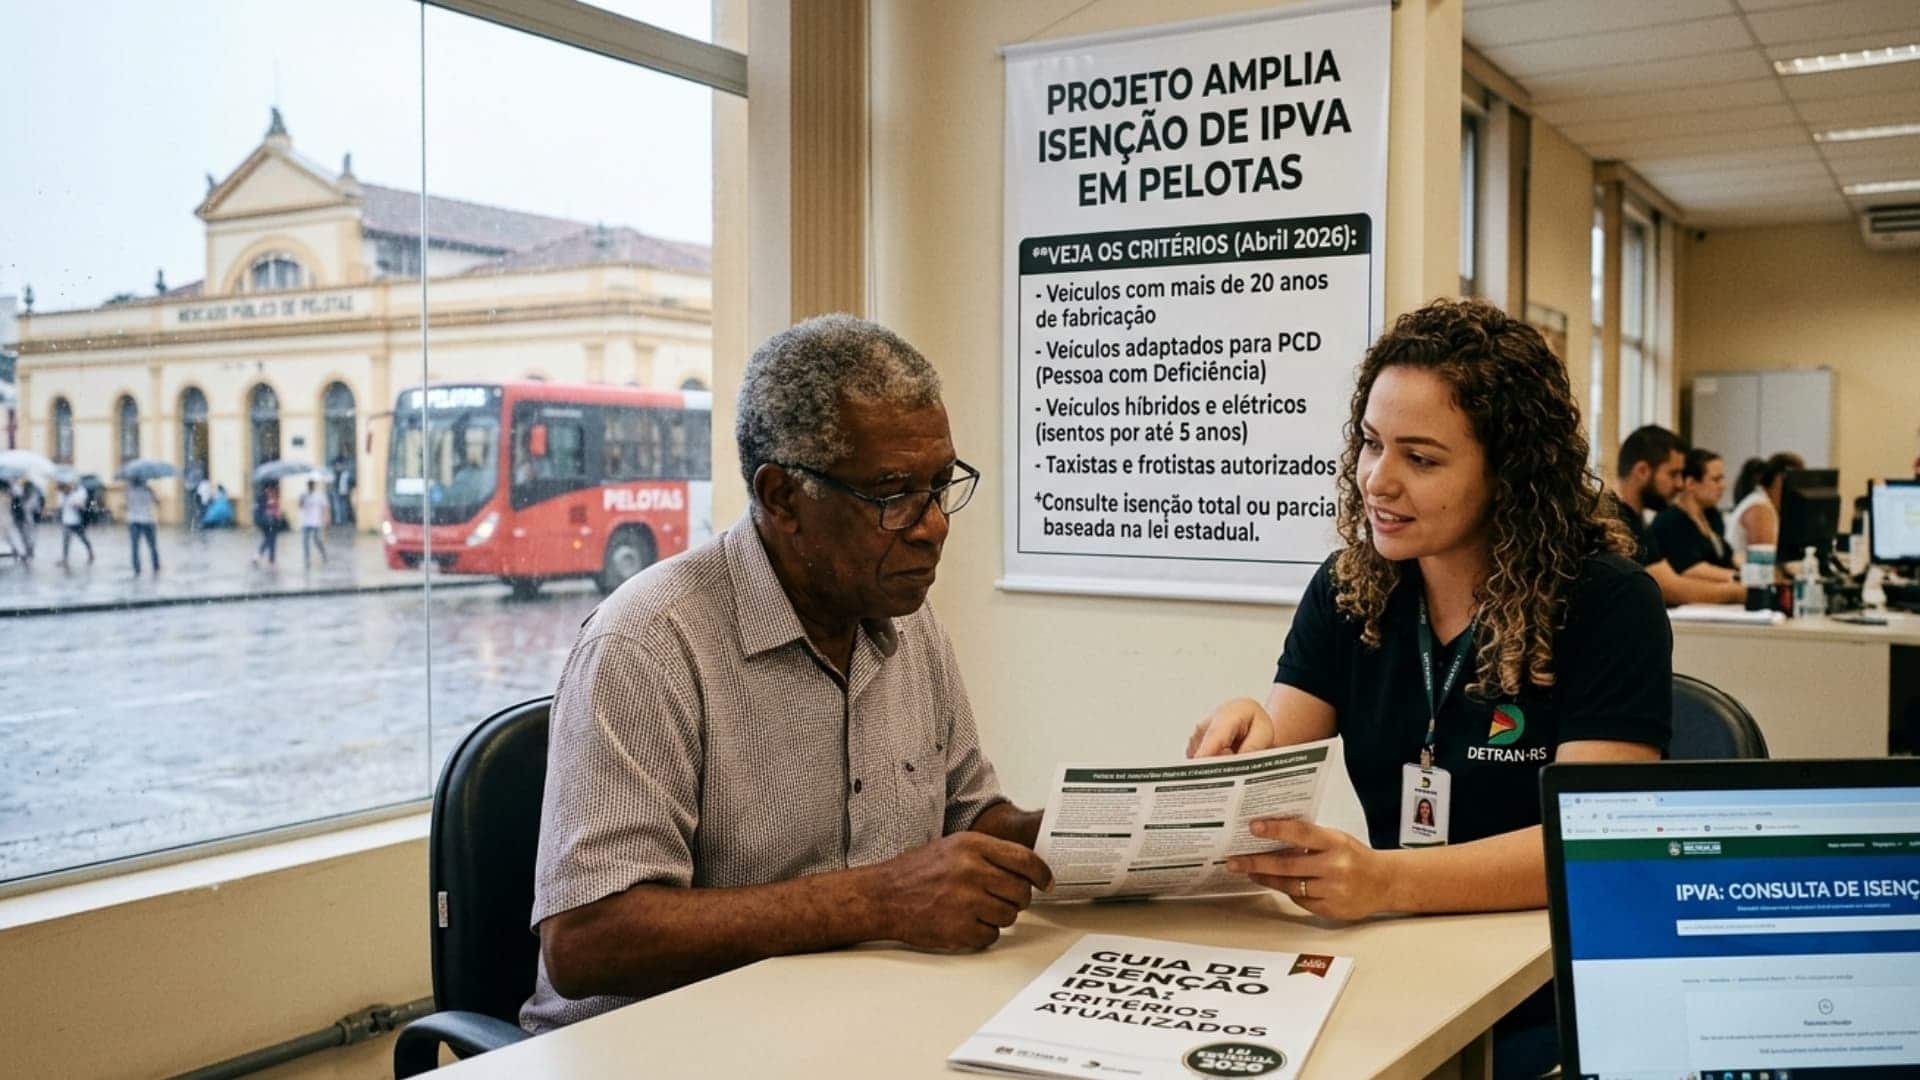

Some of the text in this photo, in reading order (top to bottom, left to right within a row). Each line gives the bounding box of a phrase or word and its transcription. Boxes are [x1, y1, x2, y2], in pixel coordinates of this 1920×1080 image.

[1047, 49, 1341, 115] PROJETO AMPLIA
[1039, 98, 1351, 164] ISENÇÃO DE IPVA
[1079, 154, 1303, 206] EM PELOTAS
[1098, 241, 1123, 261] OS
[1128, 232, 1229, 260] CRITÉRIOS
[1234, 228, 1288, 258] (Abril
[1294, 224, 1357, 251] 2026):
[1126, 282, 1165, 298] com
[1171, 274, 1215, 297] mais
[1221, 274, 1245, 294] de
[1250, 272, 1274, 293] 20
[1280, 272, 1329, 291] anos
[1036, 305, 1156, 330] de fabricação
[1046, 339, 1121, 359] Veículos
[1125, 335, 1224, 360] adaptados
[1230, 336, 1272, 358] para
[1278, 331, 1322, 352] PCD
[1036, 365, 1103, 389] (Pessoa
[1109, 367, 1148, 384] com
[1046, 396, 1120, 416] Veículos
[1125, 395, 1200, 416] híbridos
[1205, 399, 1217, 415] e
[1222, 393, 1307, 415] elétricos
[1036, 420, 1248, 447] (isentos por até 5 anos)
[1046, 454, 1118, 474] Taxistas
[1122, 458, 1133, 474] e
[1138, 454, 1215, 475] frotistas
[1221, 454, 1337, 476] autorizados
[603, 488, 684, 511] PELOTAS
[1124, 492, 1193, 518] isenção
[1198, 495, 1241, 515] total
[1246, 500, 1270, 516] ou
[1276, 496, 1337, 521] parcia
[1044, 516, 1260, 542] baseada na lei estadual.
[1467, 745, 1547, 762] DETRAN-RS
[1676, 879, 1920, 902] IPVA: CONSULTA DE ISENÇ
[1091, 951, 1266, 979] GUIA DE
[1075, 963, 1270, 995] ISENÇÃO
[1034, 1003, 1268, 1037] ATUALIZADOS
